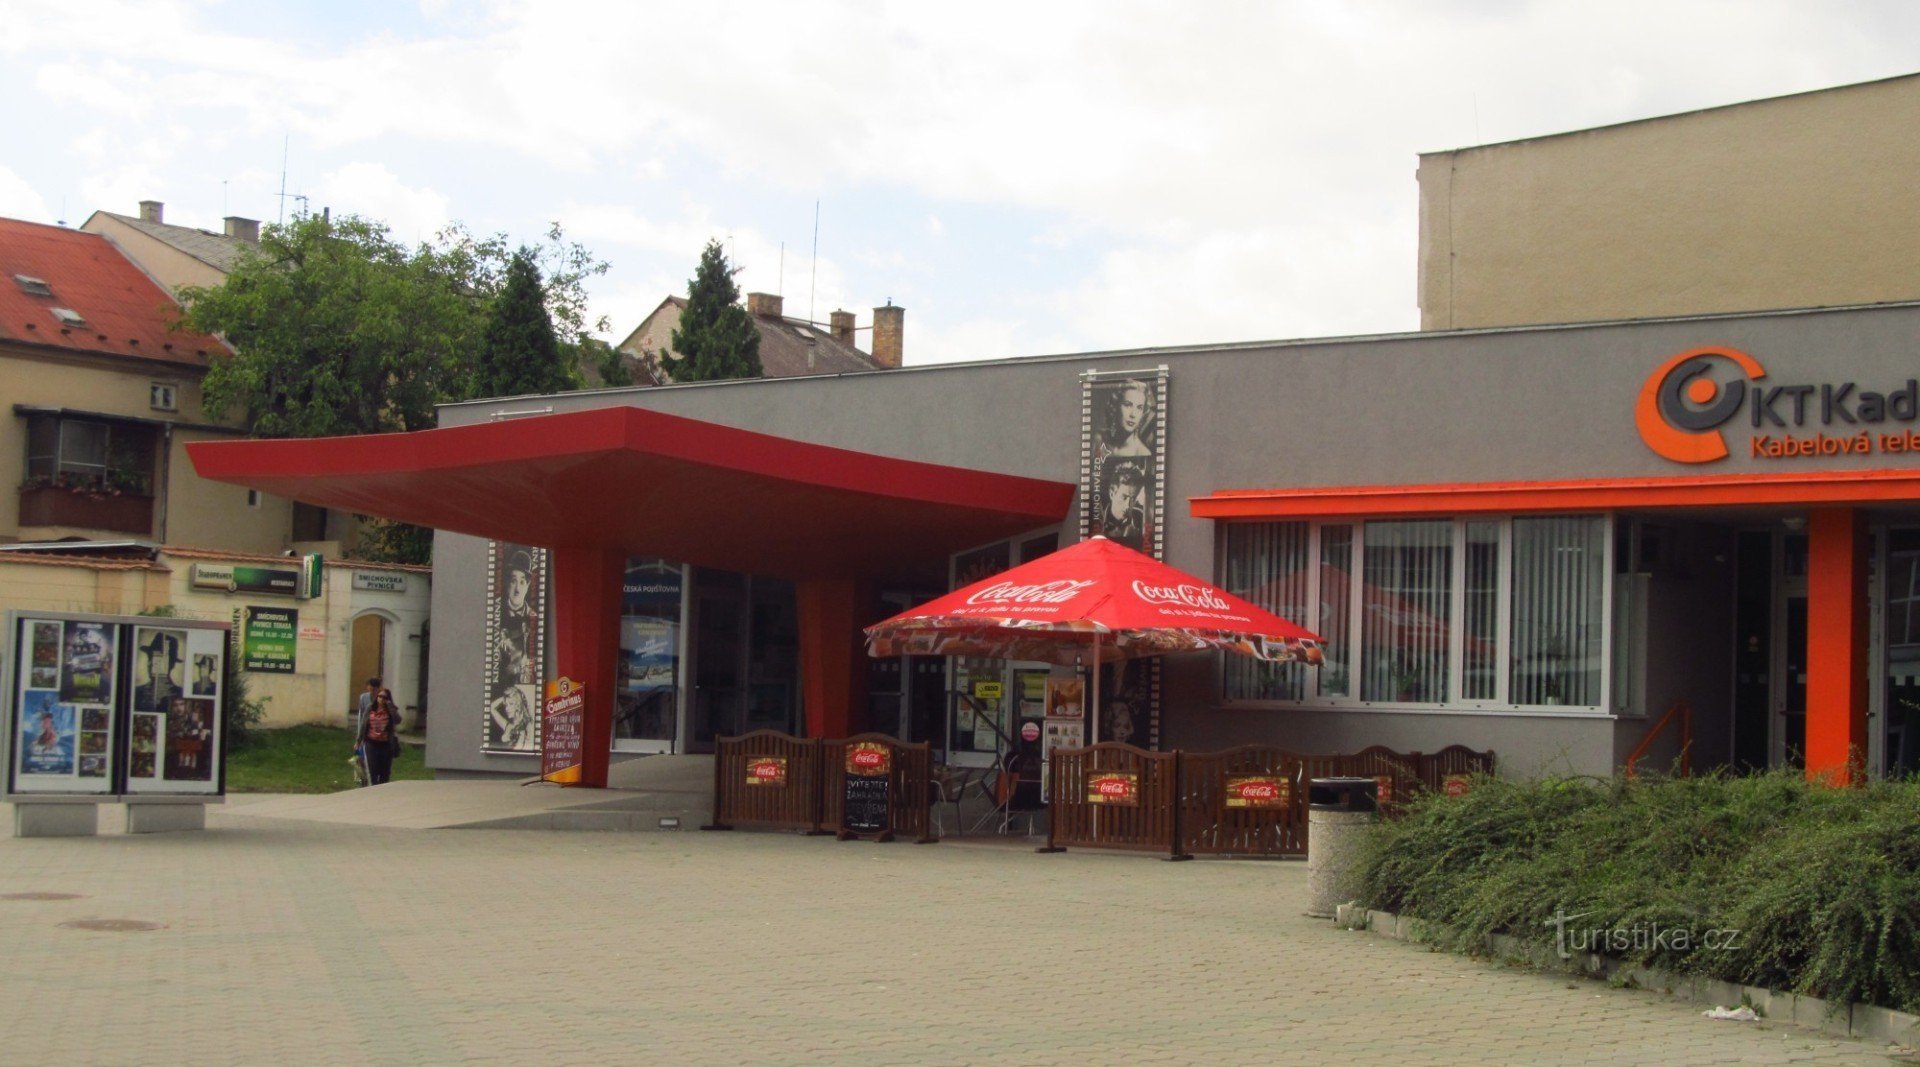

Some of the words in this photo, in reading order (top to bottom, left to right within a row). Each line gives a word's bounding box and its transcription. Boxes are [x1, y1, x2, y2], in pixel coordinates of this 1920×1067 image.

[1752, 430, 1871, 458] Kabelová
[623, 584, 642, 593] ČESKÁ
[643, 584, 680, 593] POJIŠŤOVNA
[966, 579, 1098, 605] Coca-Cola
[1131, 579, 1231, 610] Coca-Cola
[547, 694, 582, 713] Gambrinus
